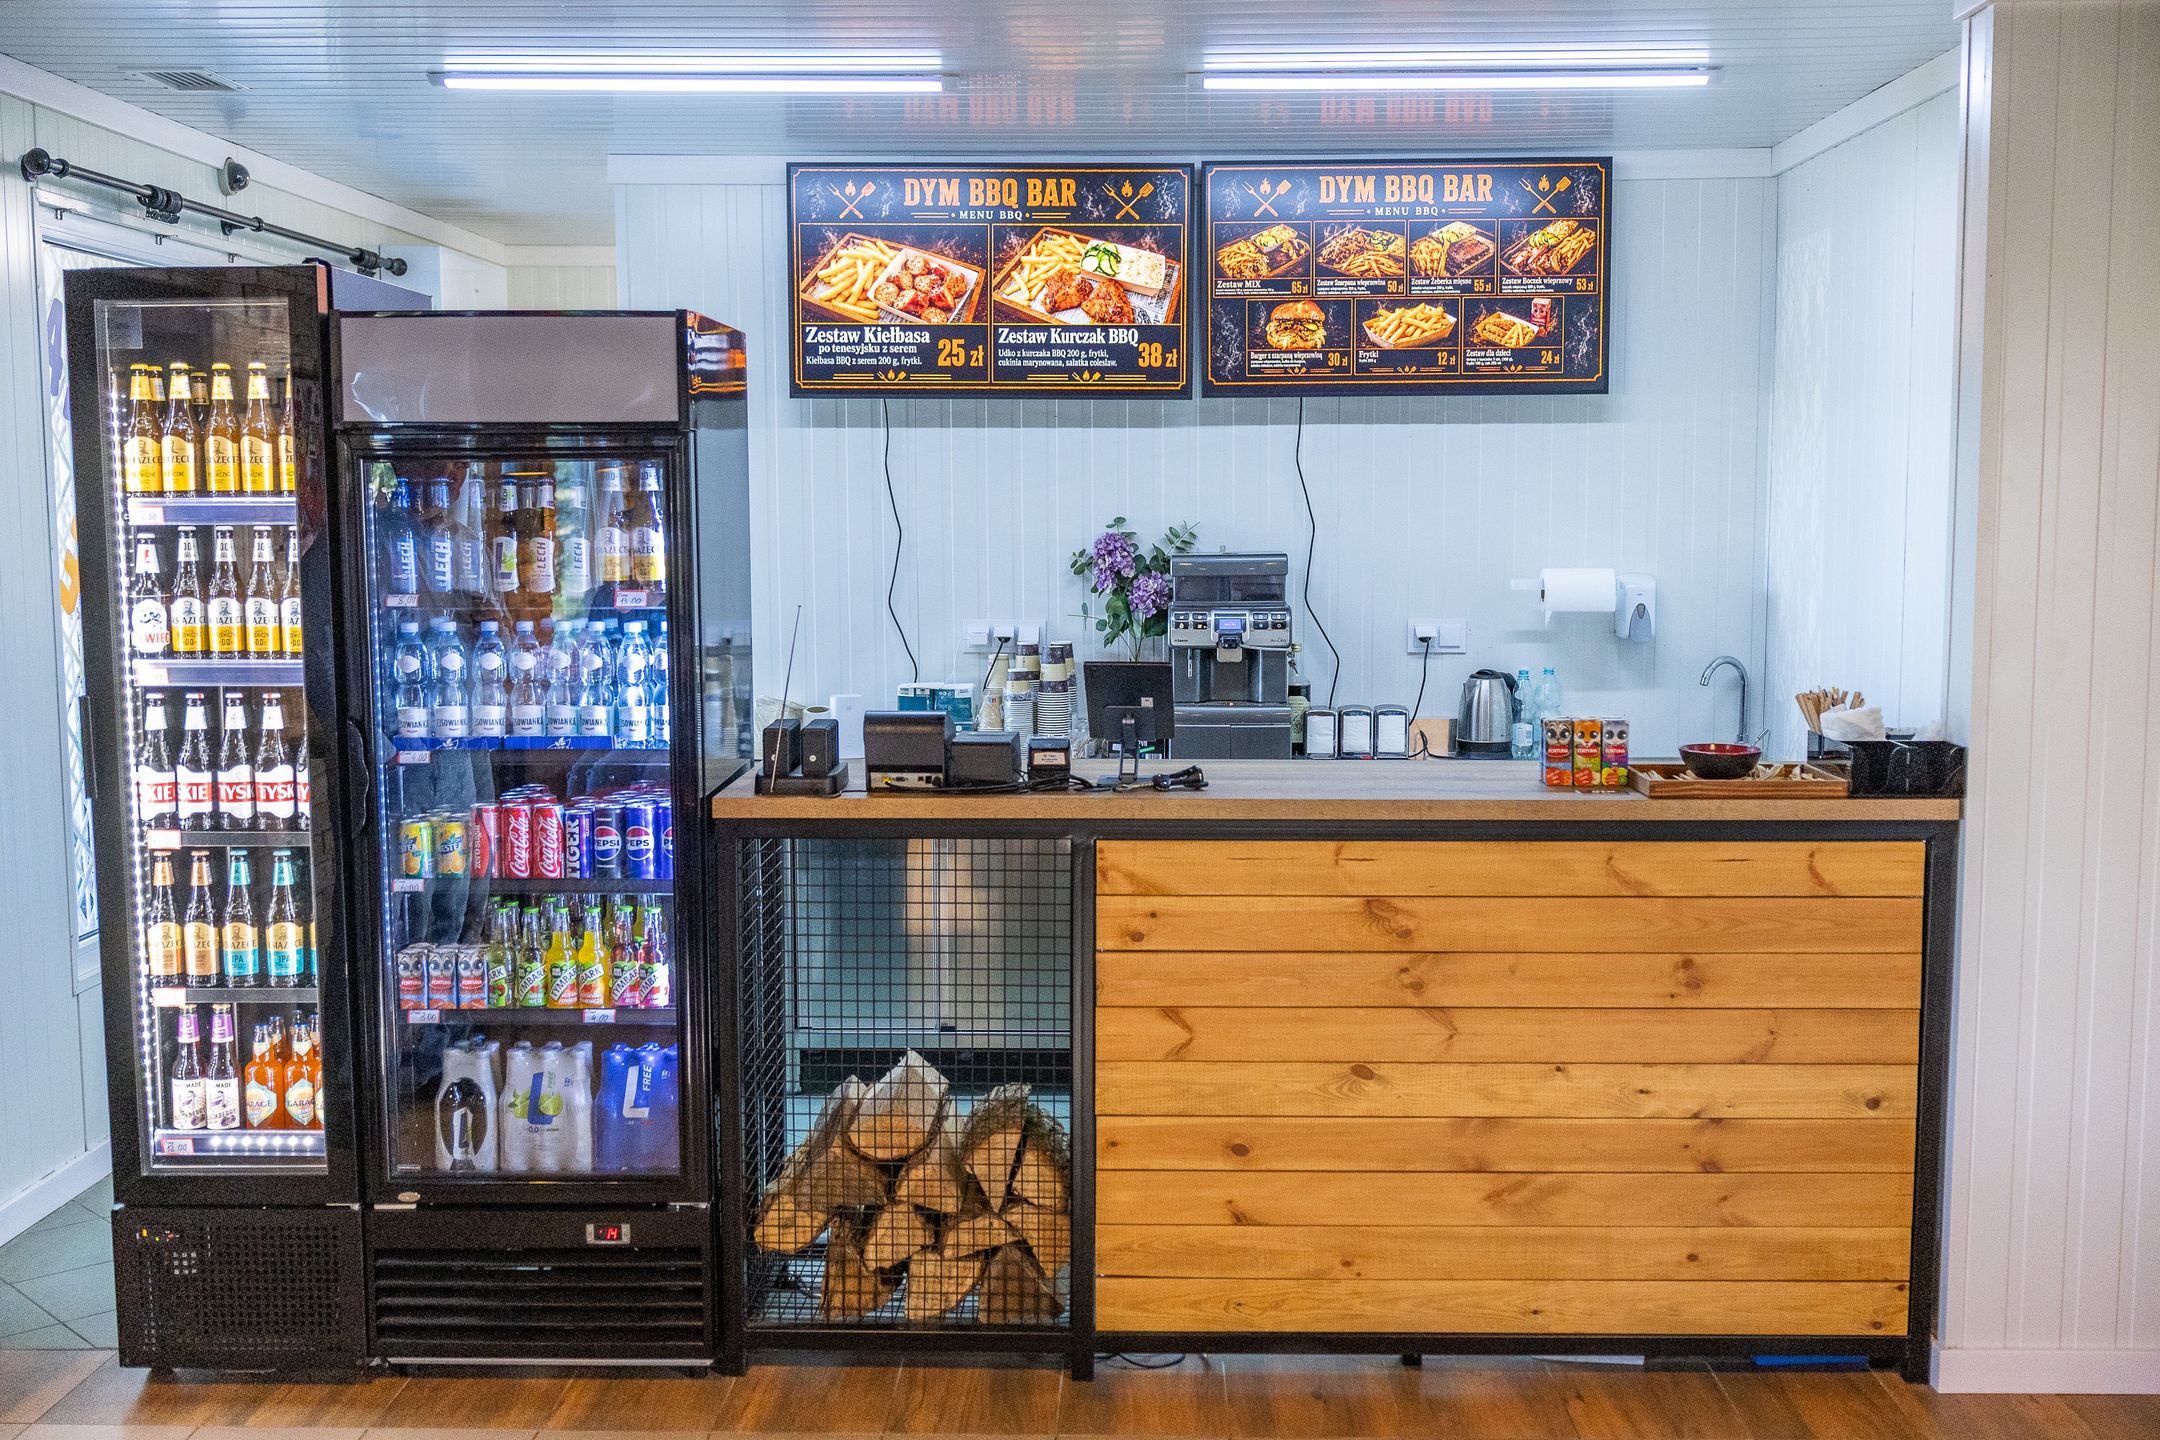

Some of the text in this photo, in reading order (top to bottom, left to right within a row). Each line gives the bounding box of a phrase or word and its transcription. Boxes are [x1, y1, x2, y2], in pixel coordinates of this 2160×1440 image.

[904, 178, 1077, 208] DYM BBQ BAR
[1319, 174, 1493, 204] DYM BBQ BAR
[959, 211, 1022, 220] MENU BBQ
[1375, 207, 1438, 216] MENU BBQ
[1292, 281, 1302, 294] 65
[1302, 284, 1308, 294] zł
[1388, 280, 1398, 292] 50
[1398, 284, 1404, 292] zł
[1474, 279, 1484, 292] 55
[1486, 283, 1492, 292] zł
[1544, 277, 1573, 285] wieprzowy
[1576, 278, 1594, 290] 53 zł
[805, 326, 930, 344] Zestaw Kiełbasa
[998, 328, 1138, 346] Zestaw Kurczak BBQ
[818, 345, 831, 354] po
[937, 338, 984, 366] 25 zł
[1052, 349, 1066, 358] BBQ
[1088, 349, 1108, 358] frytki,
[1138, 342, 1178, 368] 38 zł
[1251, 352, 1268, 360] Burger
[1358, 350, 1378, 359] Frytki
[806, 356, 834, 364] Kiełbasa
[836, 356, 851, 366] BBQ
[878, 356, 891, 364] 200
[892, 358, 900, 366] g,
[901, 356, 922, 366] frytki.
[1022, 360, 1064, 368] marynowana,
[1328, 353, 1348, 366] 30 zł
[1437, 352, 1448, 365] 12
[1450, 355, 1456, 364] zł
[1541, 351, 1560, 364] 24 zł
[435, 542, 453, 581] LECH
[463, 543, 472, 570] LECH
[537, 542, 546, 569] LECH
[574, 542, 583, 569] LECH
[643, 1064, 652, 1092] FREE
